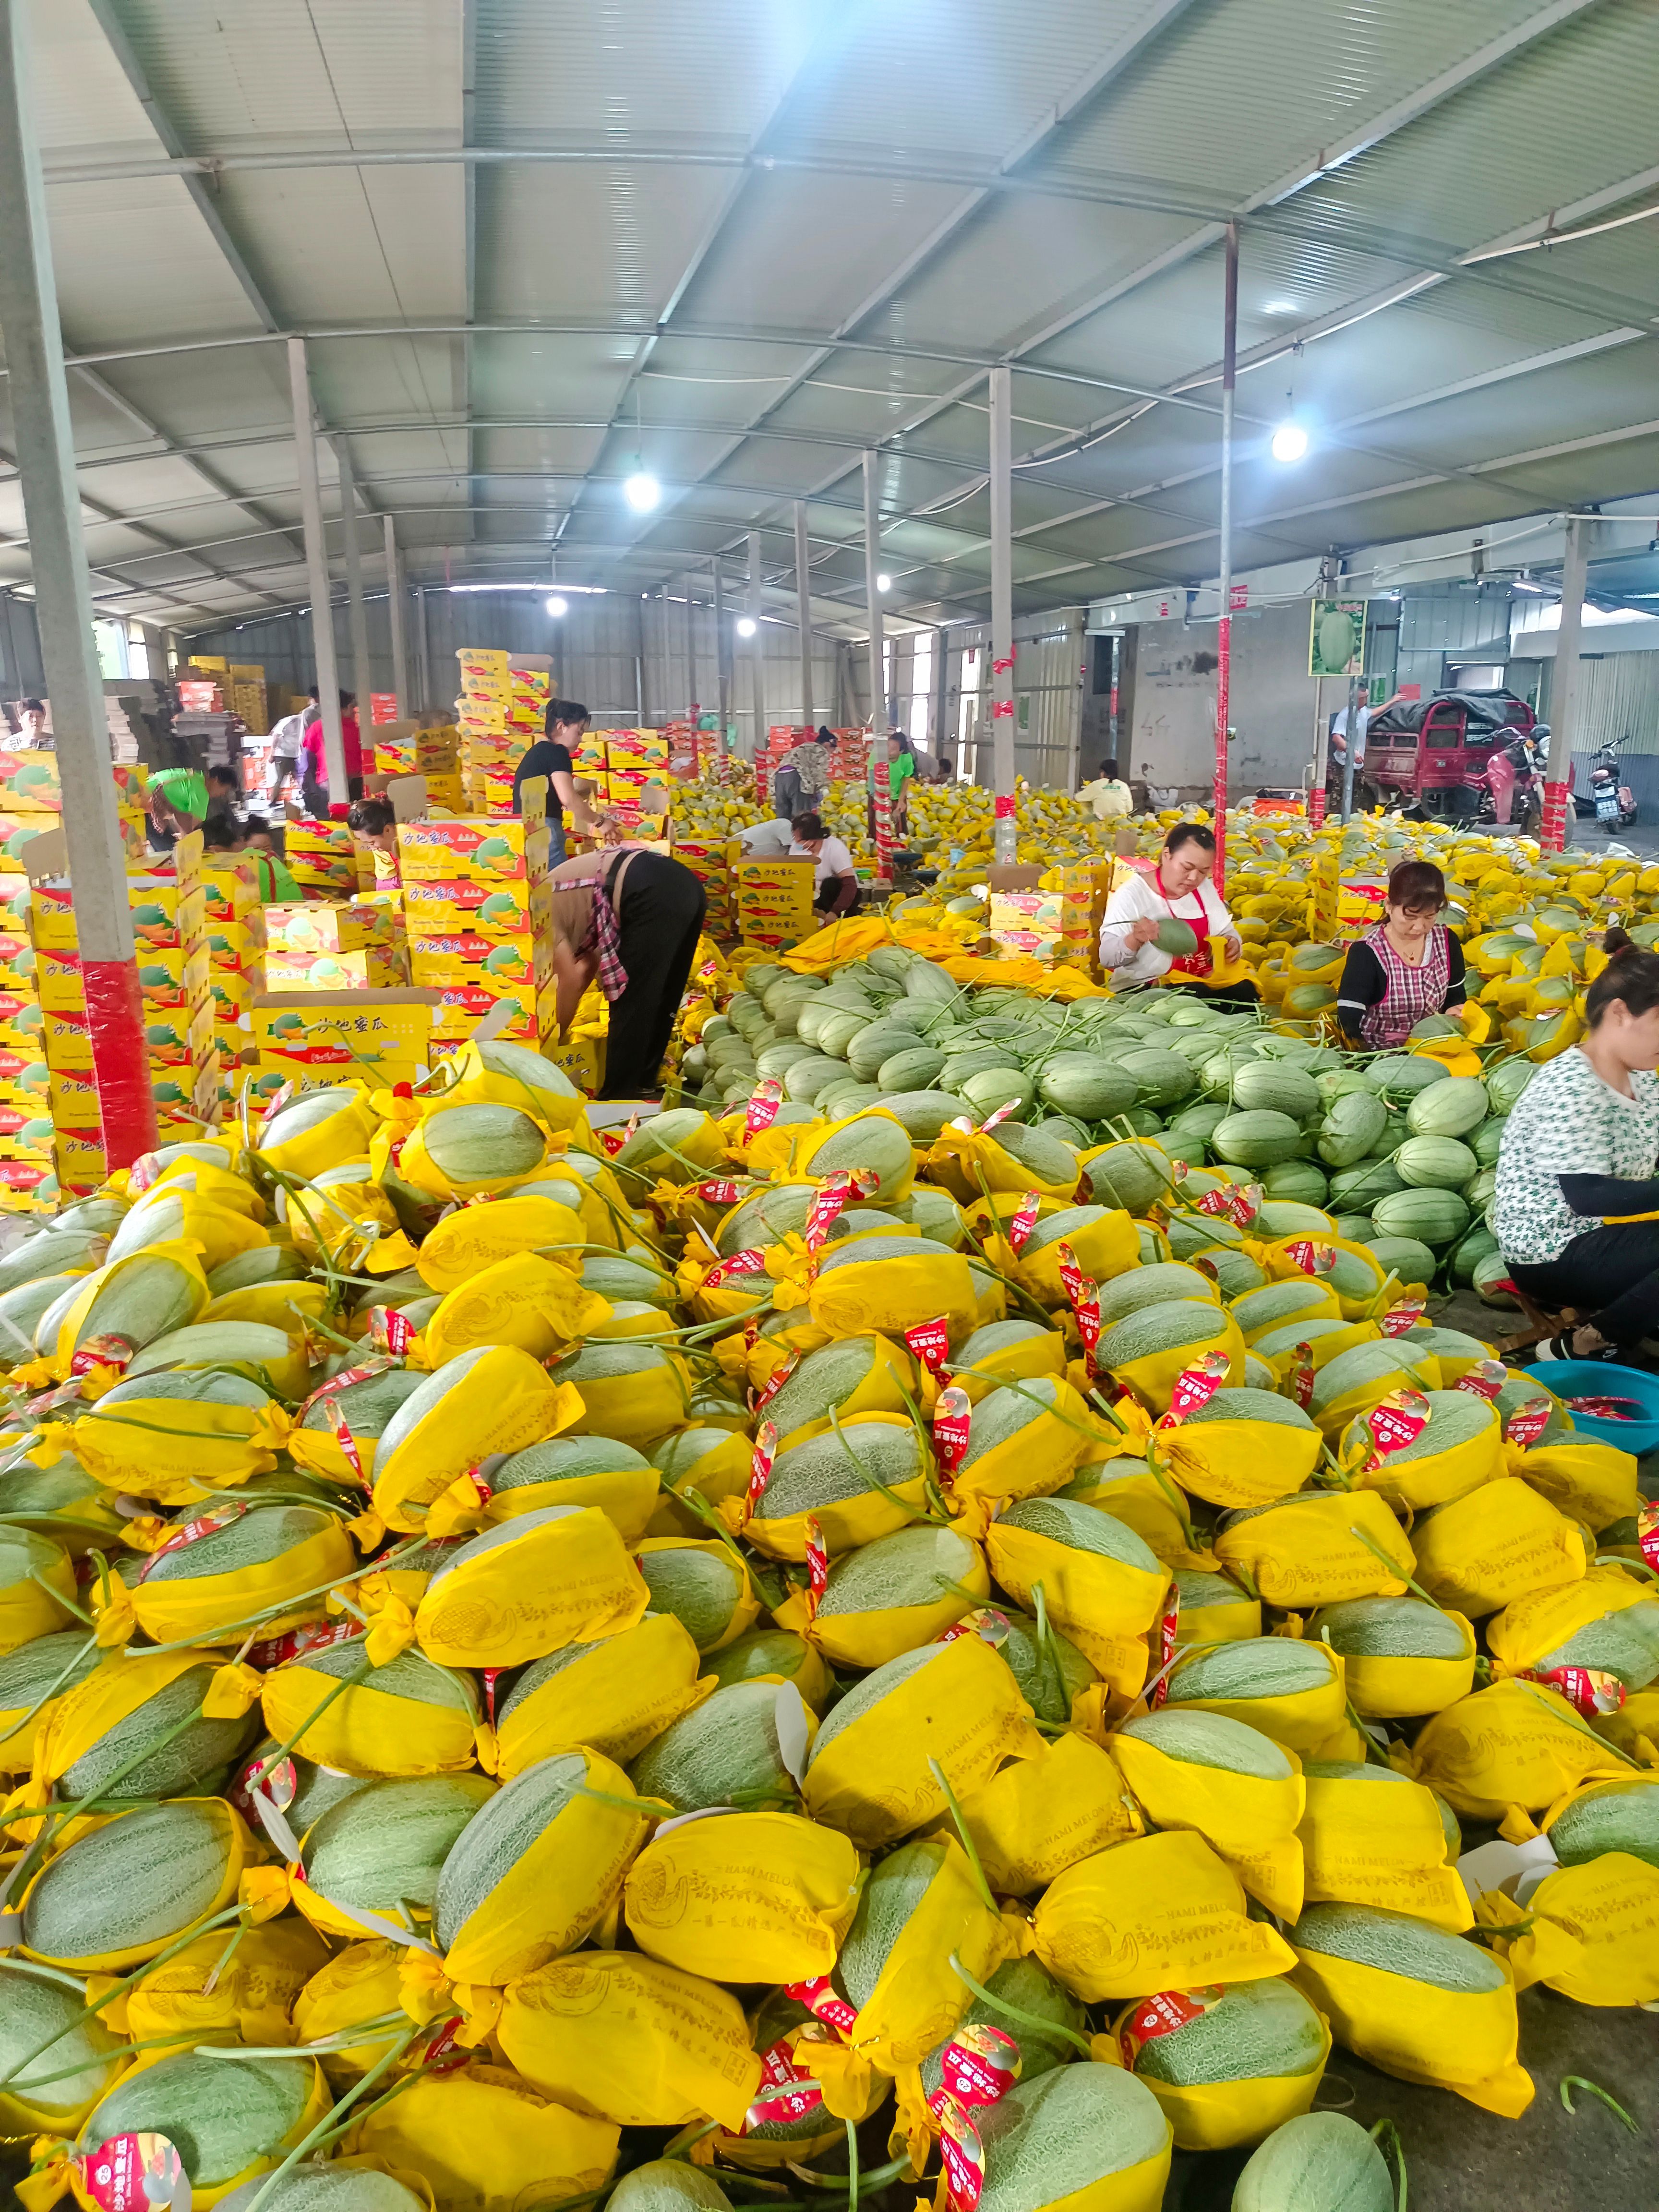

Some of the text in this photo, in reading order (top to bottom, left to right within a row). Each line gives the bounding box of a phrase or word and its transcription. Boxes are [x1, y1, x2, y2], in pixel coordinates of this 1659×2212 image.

[404, 831, 454, 845] 沙地蜜瓜
[410, 887, 460, 901] 沙地蜜瓜
[41, 902, 74, 914] 沙地
[416, 939, 465, 953] 沙地蜜瓜
[46, 963, 82, 976] 沙地
[317, 1015, 388, 1034] 沙地蜜瓜
[1178, 1377, 1210, 1400] 沙地蜜瓜
[1373, 1412, 1415, 1441] 沙地蜜瓜
[1045, 1824, 1072, 1845] HAMI
[1166, 1907, 1197, 1920] HAMI
[1150, 1995, 1182, 2027] 沙地蜜瓜
[766, 2050, 805, 2113] 沙蜜瓜
[947, 2050, 1000, 2098] 沙地蜜瓜
[958, 2079, 970, 2091] 25
[101, 2166, 108, 2181] 25
[113, 2137, 128, 2212] 沙地蜜瓜
